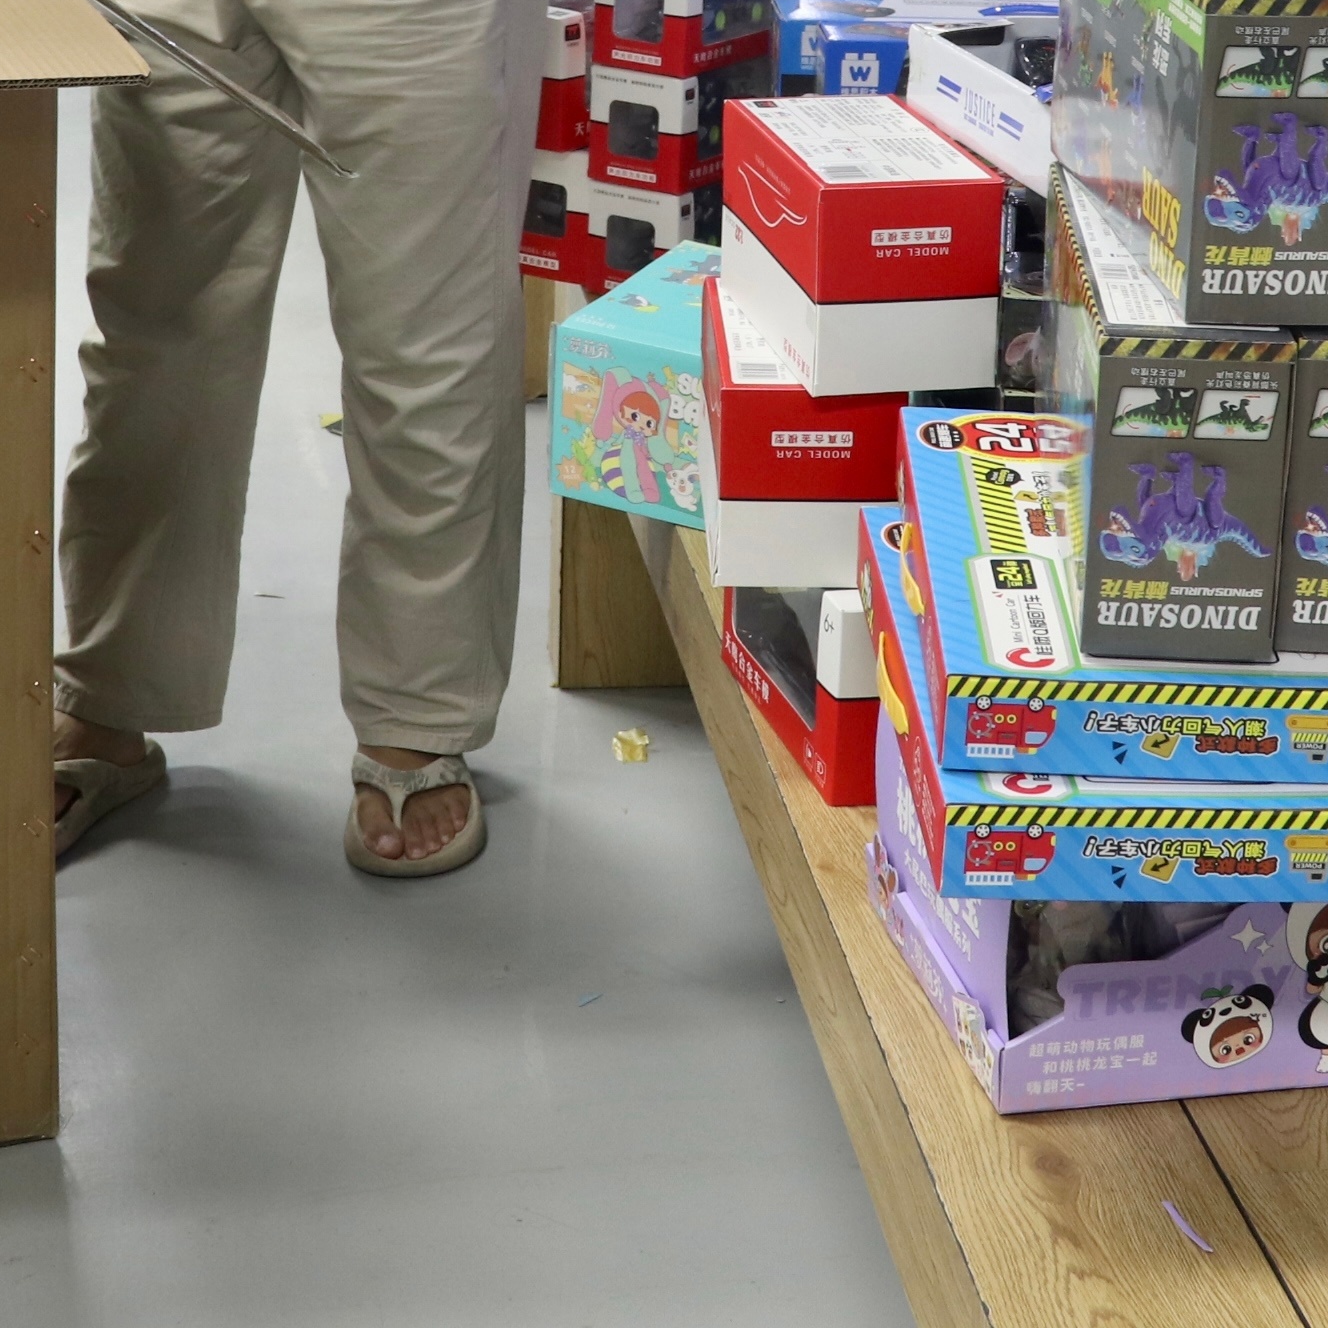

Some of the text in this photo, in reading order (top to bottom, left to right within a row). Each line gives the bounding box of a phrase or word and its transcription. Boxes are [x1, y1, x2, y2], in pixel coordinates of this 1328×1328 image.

[963, 86, 997, 129] JUSTICE
[1142, 165, 1181, 249] SAUR
[874, 230, 950, 244] 仿真合金模型
[875, 246, 950, 259] MODEL CAR
[1149, 231, 1186, 299] DINO
[774, 432, 853, 446] 仿真合金模型
[977, 421, 1028, 453] 24
[776, 448, 852, 460] MODEL CAR
[1170, 585, 1265, 599] SPINOSAURUS
[1097, 600, 1263, 632] DINOSAUR
[1195, 735, 1279, 756] 多种款式
[1294, 742, 1325, 751] POWER
[1195, 857, 1278, 877] 多种款式
[1293, 860, 1325, 869] POWER
[1028, 1034, 1145, 1059] 超萌动物玩偶服
[1042, 1051, 1158, 1075] 和桃桃龙宝一起
